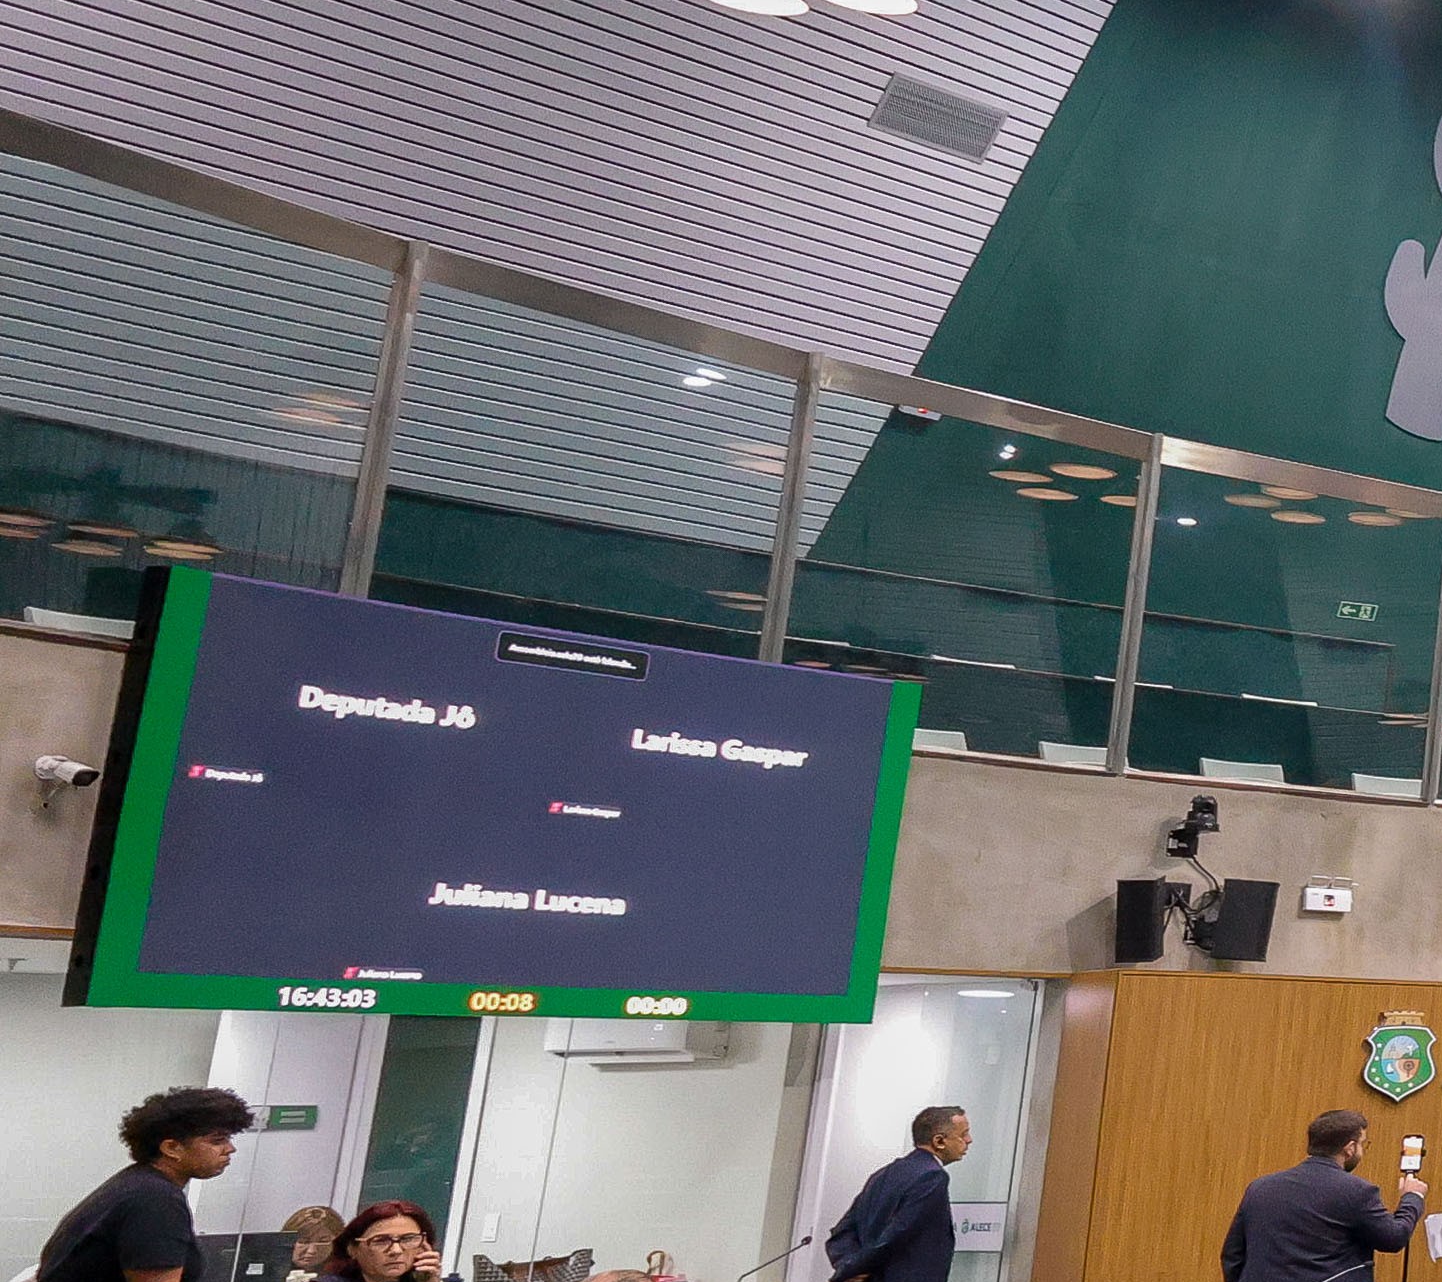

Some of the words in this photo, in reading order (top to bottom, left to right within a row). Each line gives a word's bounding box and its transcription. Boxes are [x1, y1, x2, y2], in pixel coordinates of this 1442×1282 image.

[299, 685, 435, 724] Deputada
[439, 705, 476, 729] Jô
[631, 728, 717, 757] Larissa
[720, 739, 808, 769] Gaspar
[428, 883, 528, 910] Juliana
[534, 889, 627, 916] Lucena
[278, 986, 377, 1009] 16:43:03
[469, 991, 535, 1012] 00:08
